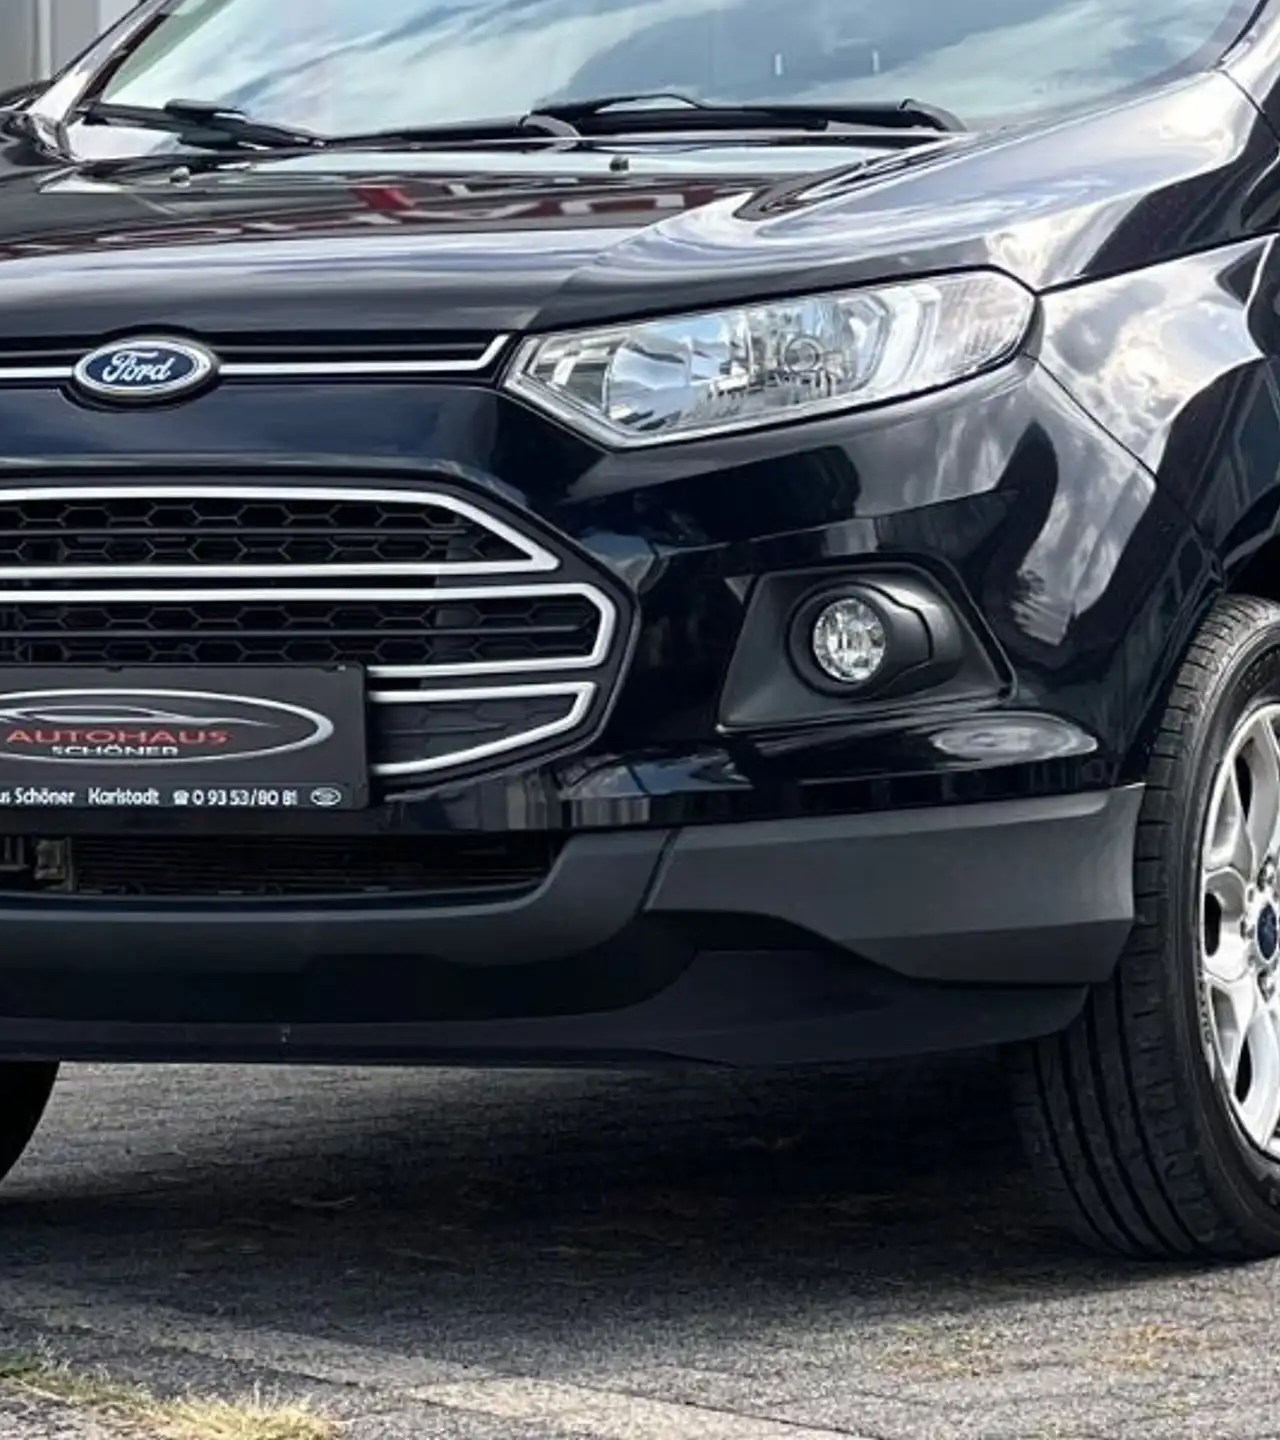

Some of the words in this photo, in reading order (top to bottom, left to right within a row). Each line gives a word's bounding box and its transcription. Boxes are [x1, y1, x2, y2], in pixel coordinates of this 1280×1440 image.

[102, 350, 175, 383] Ford
[6, 728, 230, 745] AUTOHAUS
[51, 744, 179, 757] SCHÖNER
[14, 786, 76, 806] Schöner
[87, 787, 160, 806] Karlstadt
